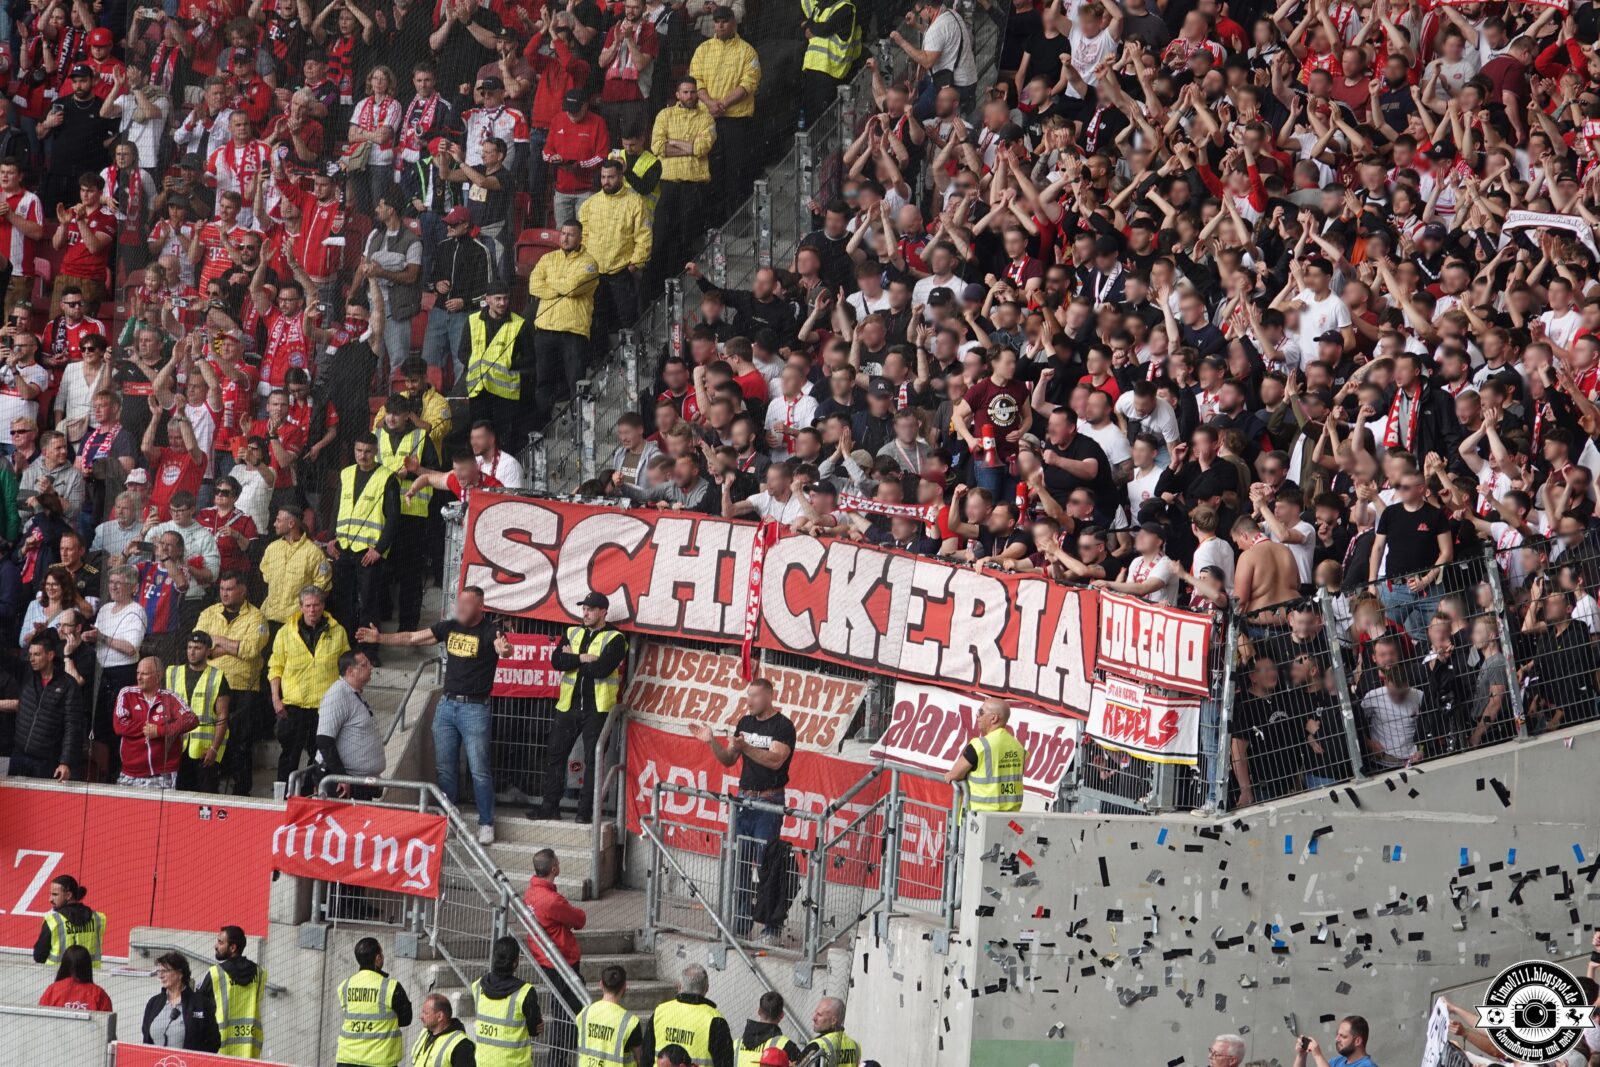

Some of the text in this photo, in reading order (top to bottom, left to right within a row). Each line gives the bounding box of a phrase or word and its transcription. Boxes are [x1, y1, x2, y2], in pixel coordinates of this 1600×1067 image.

[465, 499, 1092, 717] SCHICKERIA
[1100, 597, 1206, 682] COLEGIO
[626, 680, 730, 723] IMMER
[637, 646, 865, 714] AUSGESERRTE
[887, 691, 1075, 786] alarMtufe
[1102, 702, 1180, 751] REBELS
[635, 759, 740, 825] ADLE
[0, 848, 64, 917] Z
[347, 987, 379, 1003] SECURITY
[479, 1023, 498, 1037] 3501
[588, 1022, 615, 1042] SECURITY
[665, 1026, 695, 1046] SECURITY
